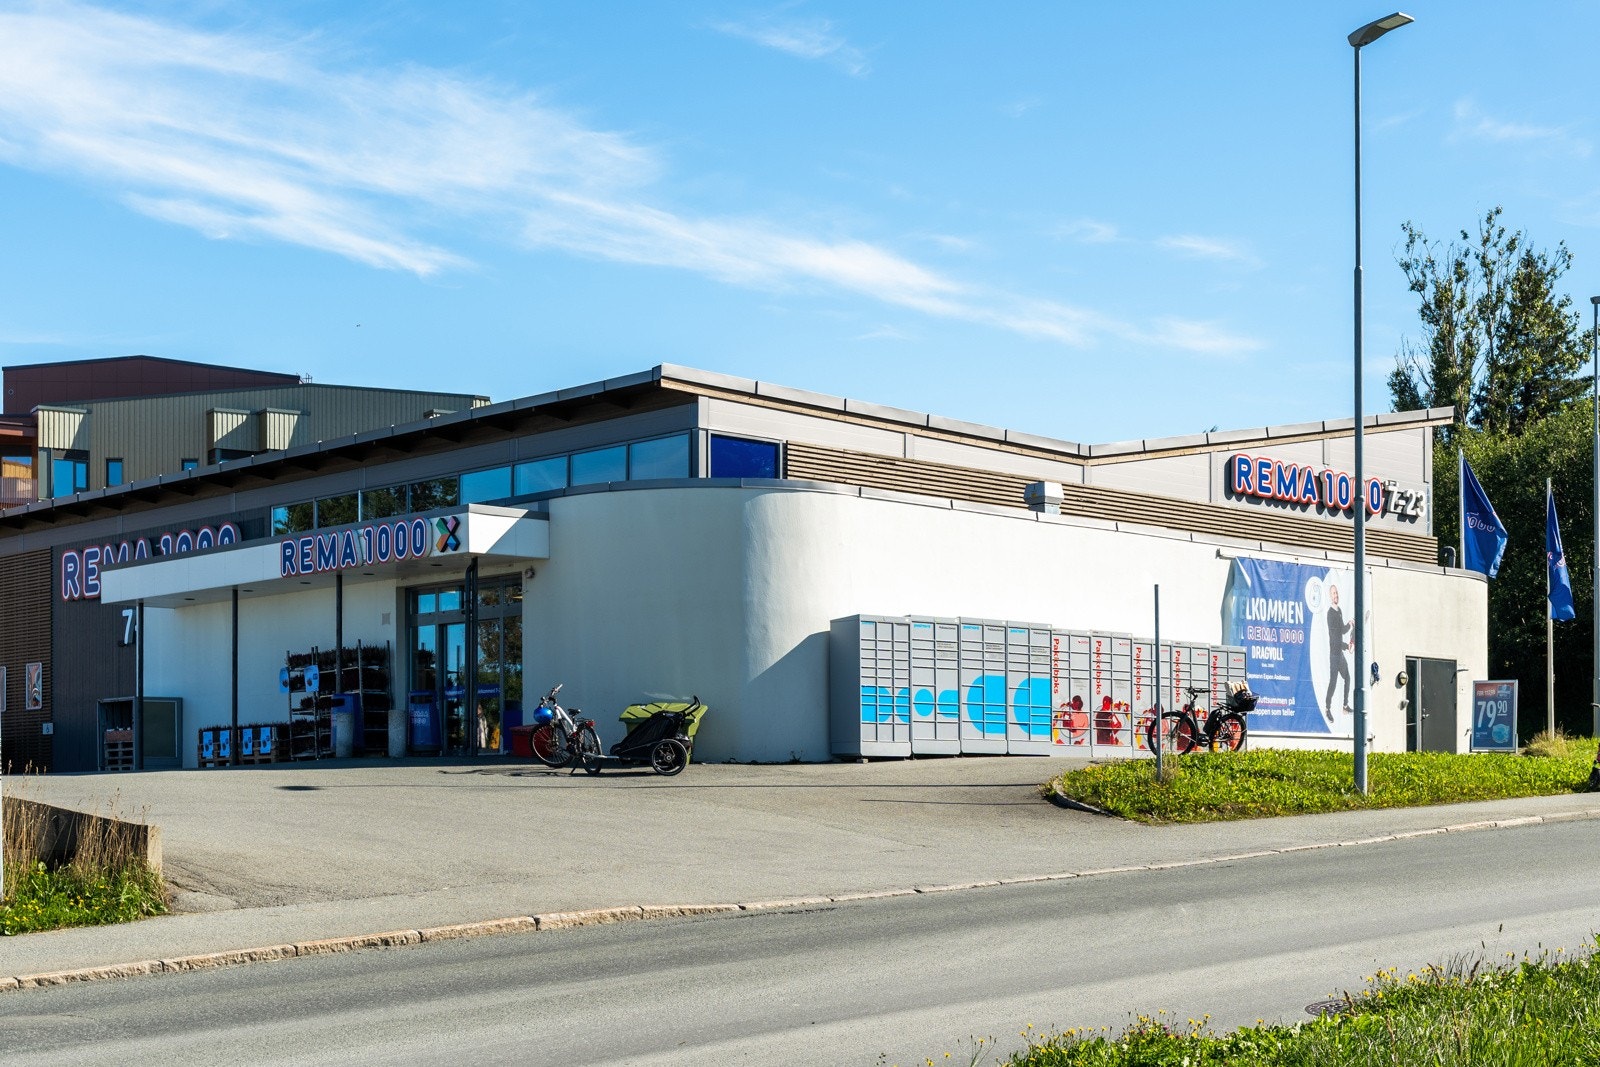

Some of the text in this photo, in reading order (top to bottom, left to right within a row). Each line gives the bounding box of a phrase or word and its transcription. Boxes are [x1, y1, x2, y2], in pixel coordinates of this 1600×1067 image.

[1233, 454, 1319, 505] REMA
[1386, 482, 1426, 517] 7-23
[281, 530, 357, 578] REMA
[363, 517, 427, 566] 1000
[1247, 626, 1305, 644] REMA 1000
[1251, 646, 1284, 661] DRAGVOLL
[1271, 708, 1282, 716] som
[1282, 708, 1296, 717] teller
[1288, 696, 1296, 706] på
[1477, 700, 1508, 728] 79 90
